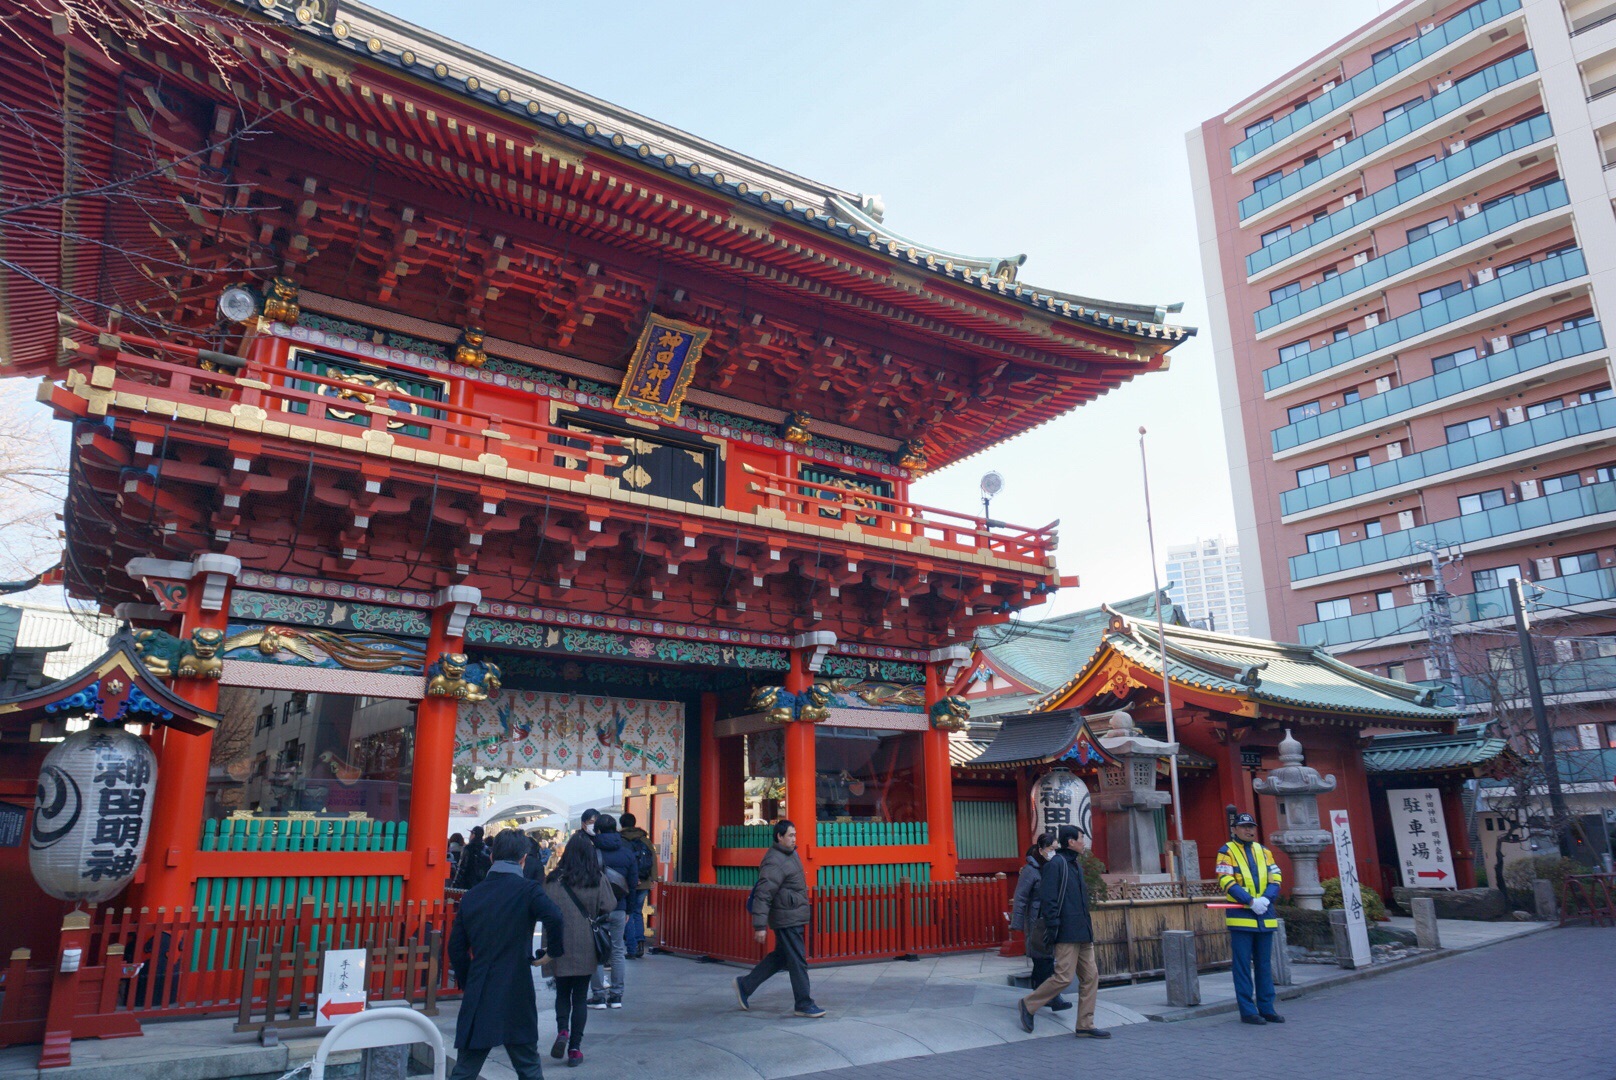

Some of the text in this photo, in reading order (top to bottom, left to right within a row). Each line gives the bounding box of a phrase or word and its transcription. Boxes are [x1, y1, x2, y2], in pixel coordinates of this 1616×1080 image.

[639, 331, 683, 402] 神田神社
[82, 752, 150, 881] 神田明神
[1403, 797, 1430, 860] 駐車場
[1425, 793, 1438, 824] 神田神社
[1341, 830, 1362, 919] 手水舎
